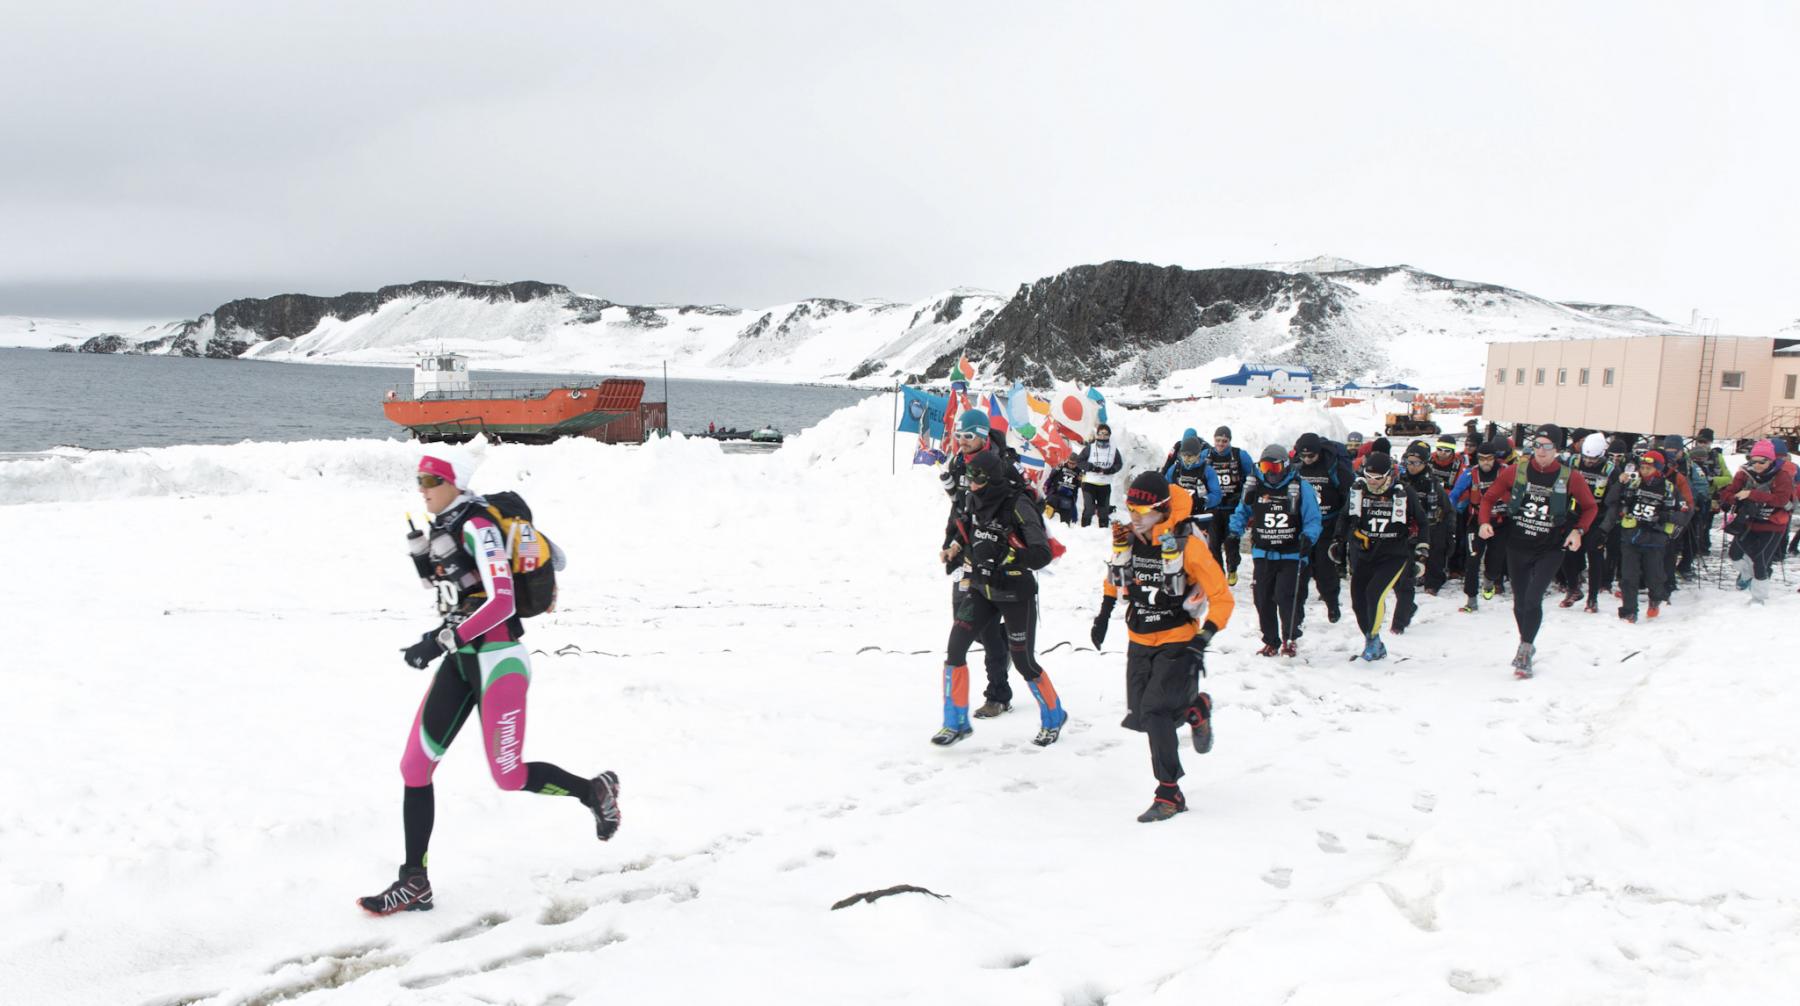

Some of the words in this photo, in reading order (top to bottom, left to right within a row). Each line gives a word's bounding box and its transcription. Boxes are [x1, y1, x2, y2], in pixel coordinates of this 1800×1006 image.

[1128, 487, 1158, 504] ORTH
[1529, 494, 1546, 502] Kyle
[1523, 502, 1549, 520] 31
[1632, 503, 1656, 517] 55
[1264, 513, 1289, 528] 52
[1368, 517, 1389, 532] 17
[1141, 586, 1159, 605] 7
[1144, 614, 1161, 623] 2016
